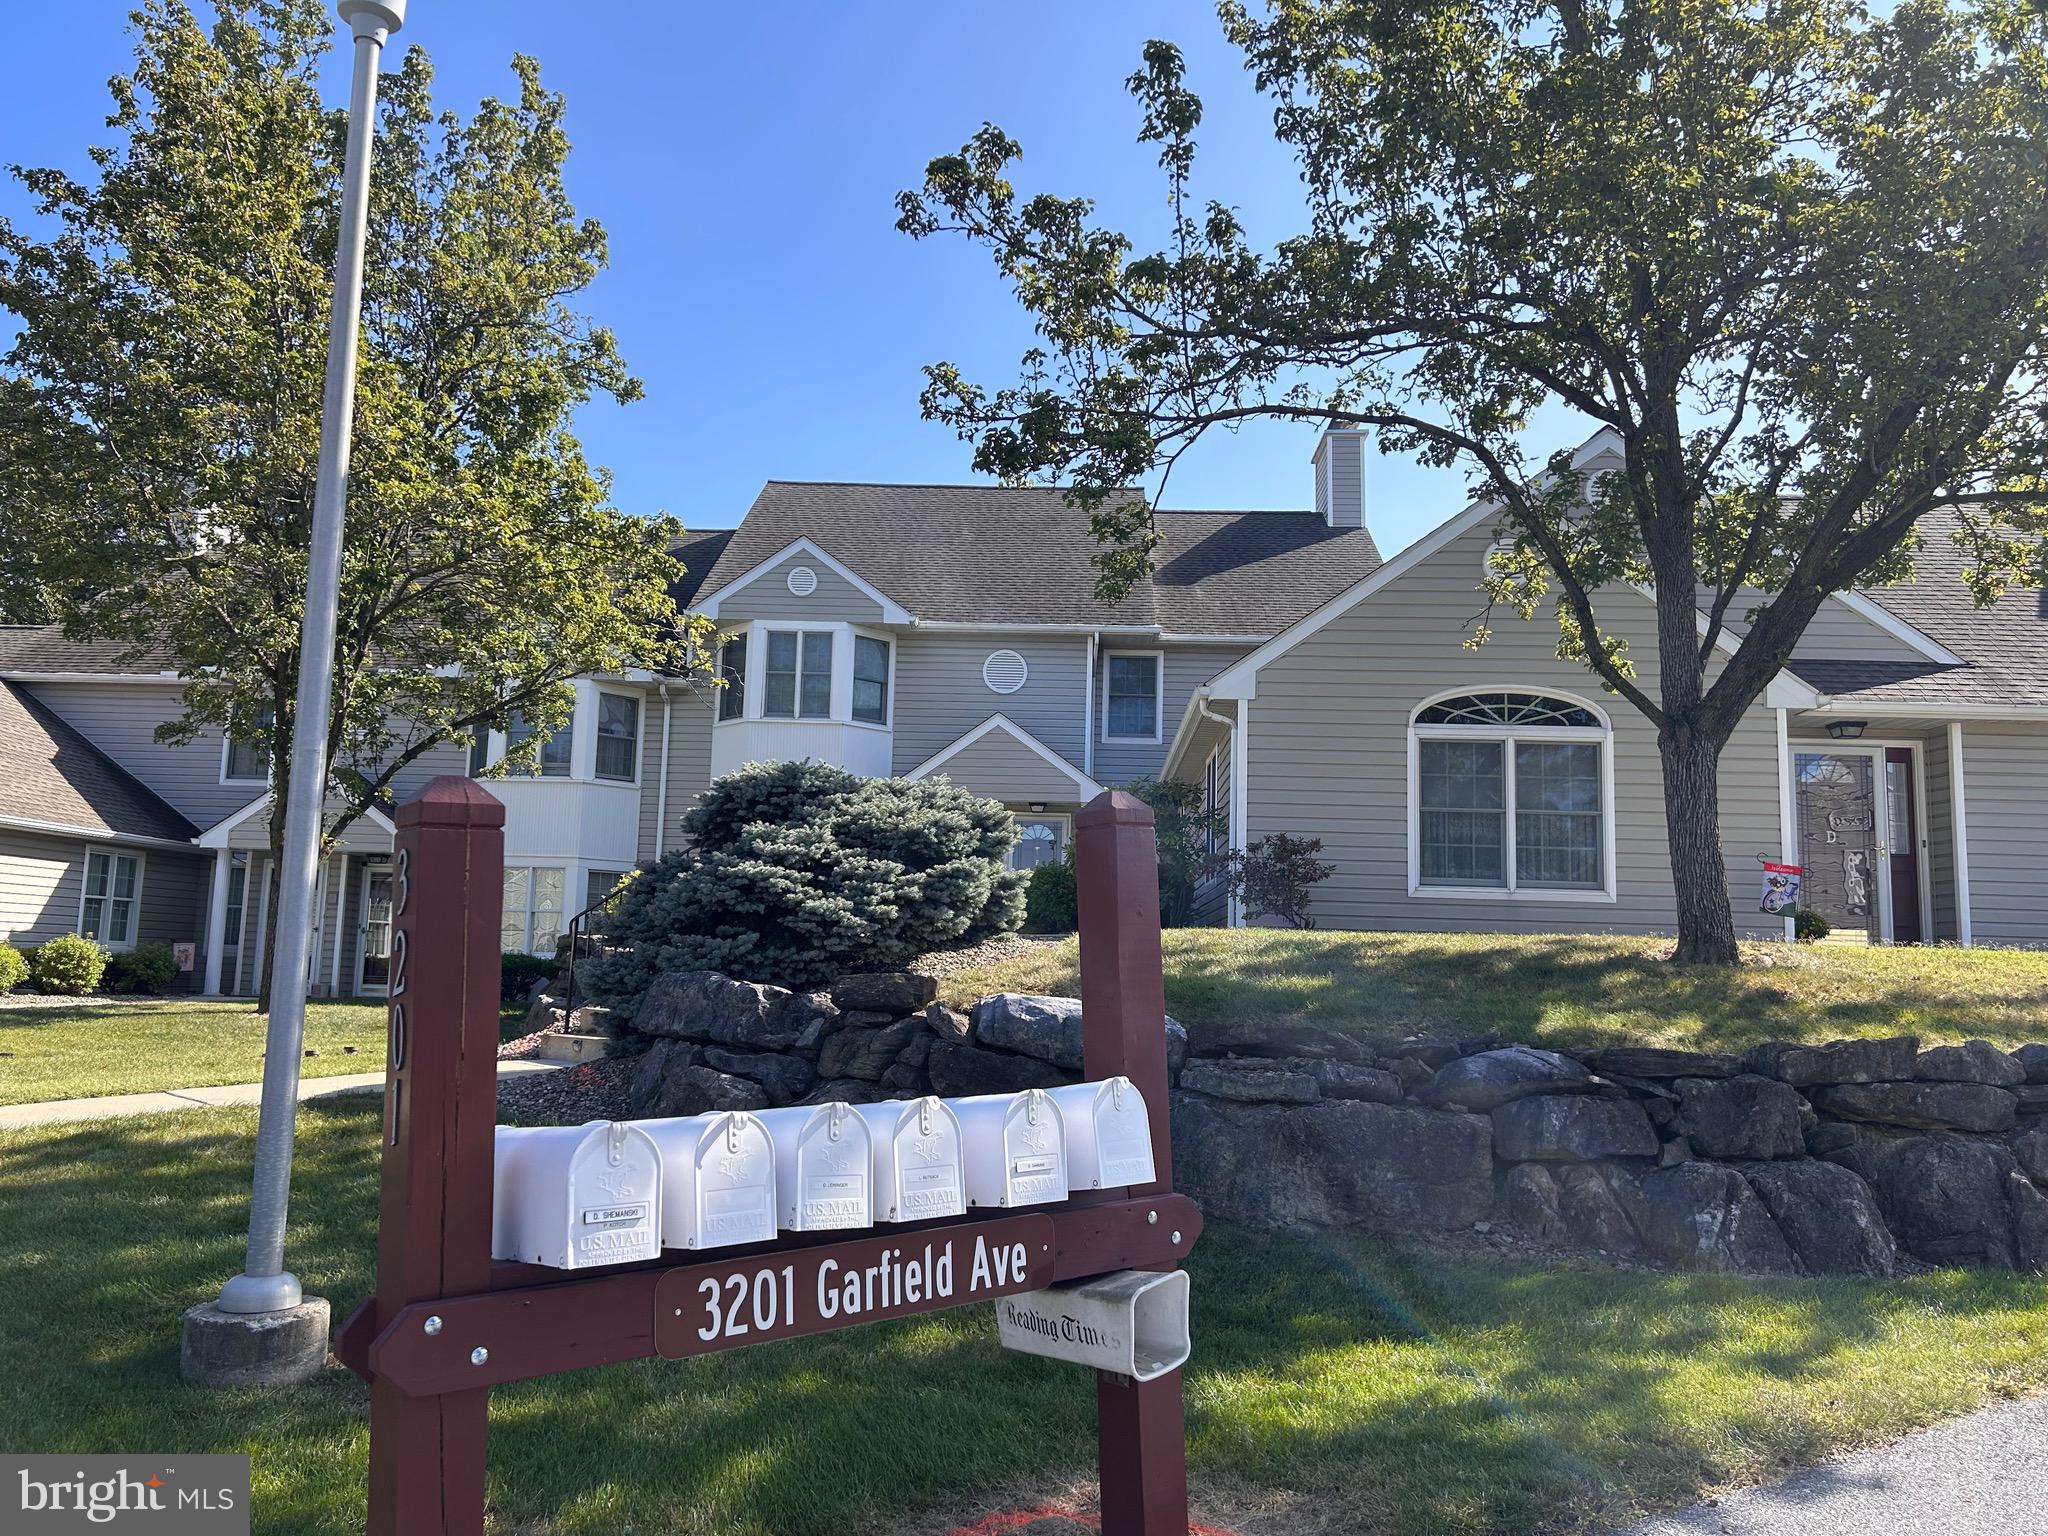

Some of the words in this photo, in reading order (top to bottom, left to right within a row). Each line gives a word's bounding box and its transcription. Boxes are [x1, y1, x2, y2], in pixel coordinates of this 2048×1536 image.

[389, 848, 409, 1147] 3201
[926, 1190, 958, 1206] MAIL
[593, 1212, 600, 1221] D.
[602, 1208, 639, 1219] SHEMANSKI
[828, 1201, 864, 1215] MAIL
[609, 1231, 649, 1249] MAIL
[697, 1264, 794, 1342] 3201
[816, 1240, 954, 1319] Garfield
[969, 1235, 1027, 1292] Ave
[1007, 1301, 1060, 1343] Reading
